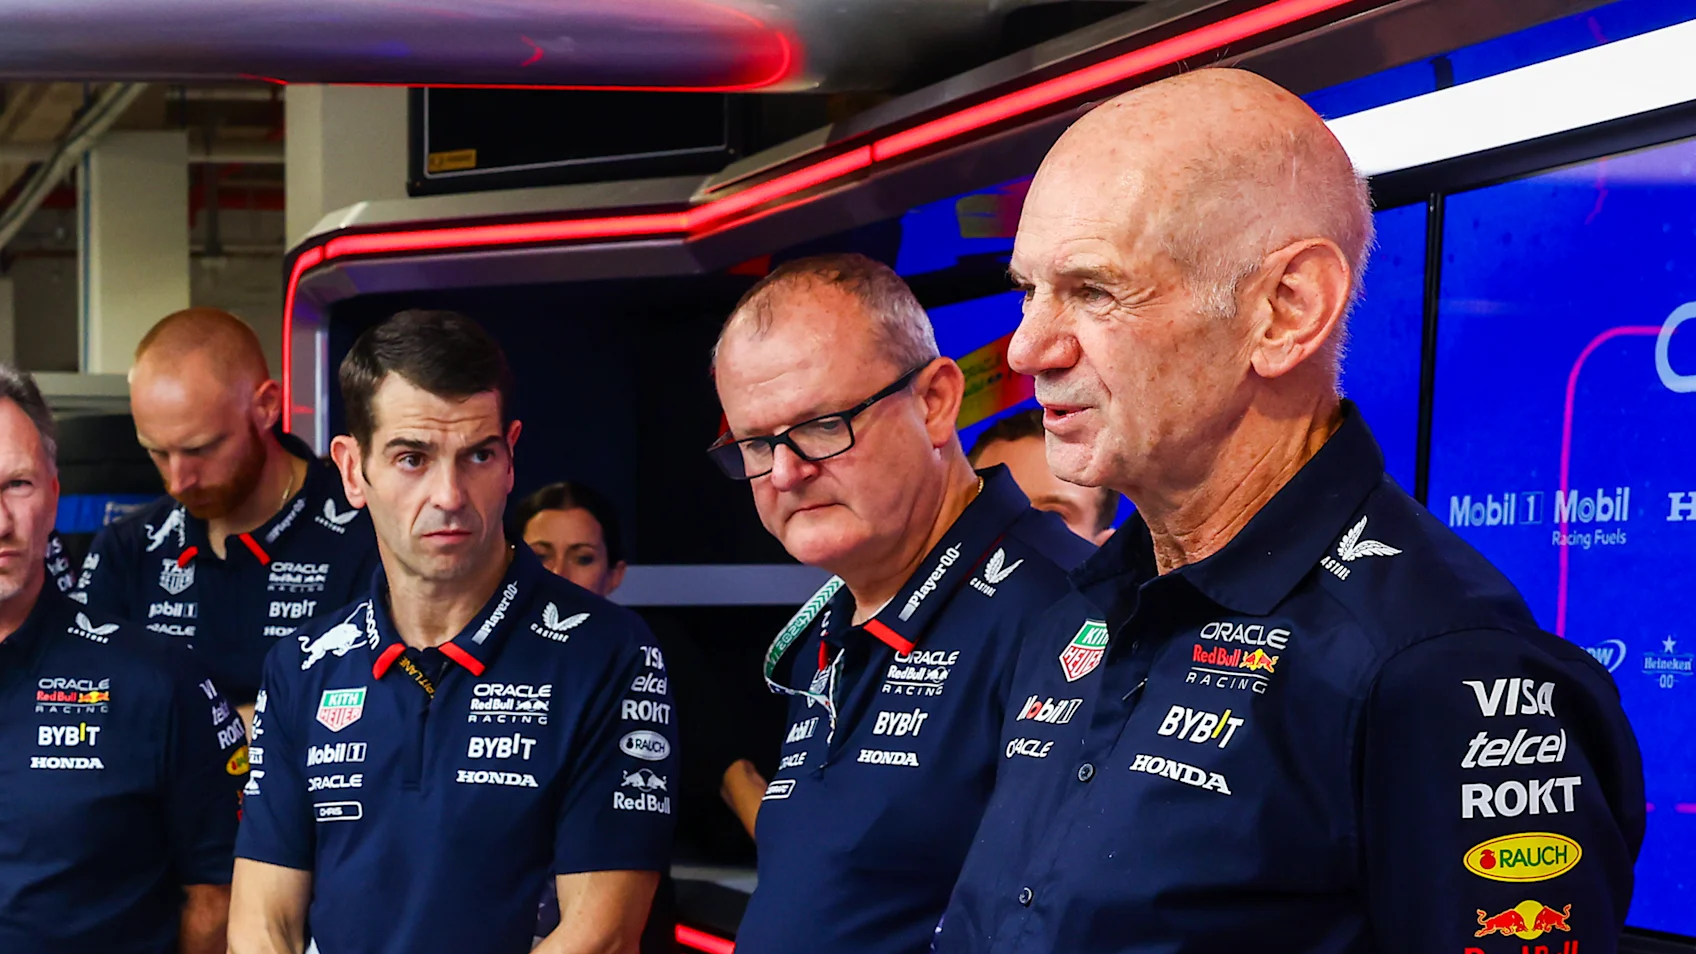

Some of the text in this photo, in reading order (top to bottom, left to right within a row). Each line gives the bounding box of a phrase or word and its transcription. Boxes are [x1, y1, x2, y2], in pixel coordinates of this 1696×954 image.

[1449, 493, 1536, 528] Mobil 1
[1554, 487, 1630, 523] Mobil
[1552, 528, 1626, 550] Racing Fuels
[271, 562, 330, 574] ORACLE
[1319, 554, 1351, 582] ASTORE
[969, 576, 997, 598] CASTORE
[269, 599, 317, 619] BYBIT
[530, 622, 570, 644] CASTORE
[778, 618, 805, 652] 2024
[1199, 621, 1291, 650] ORACLE
[894, 651, 960, 667] ORACLE
[1192, 643, 1242, 669] Red Bull
[1644, 656, 1692, 672] Heineken
[630, 672, 668, 696] elcel
[887, 665, 926, 682] Red Bull
[1185, 670, 1268, 696] RACING
[36, 690, 77, 702] Red Bull
[38, 678, 110, 692] ORACLE
[473, 683, 553, 698] ORACLE
[882, 684, 944, 697] RACING
[35, 702, 109, 714] RACING
[329, 691, 360, 707] KITH
[470, 698, 514, 711] Red Bull
[1016, 694, 1067, 724] Mobil
[1460, 678, 1556, 718] VISA
[468, 714, 548, 725] RACING
[621, 699, 671, 725] ROKT
[873, 708, 929, 737] BYBIT
[38, 722, 100, 747] BYBIT
[1158, 704, 1245, 750] BYBIT
[468, 732, 538, 760] BYBIT
[635, 738, 665, 754] RAUCH
[1006, 738, 1055, 759] OACLE
[1460, 727, 1566, 769] telcel
[30, 756, 104, 770] HONDA
[857, 749, 920, 768] HONDA
[456, 769, 539, 788] HONDA
[1129, 754, 1232, 796] HONDA
[613, 791, 671, 814] Red Bull
[1461, 776, 1582, 819] ROKT
[1497, 844, 1569, 868] RAUCH
